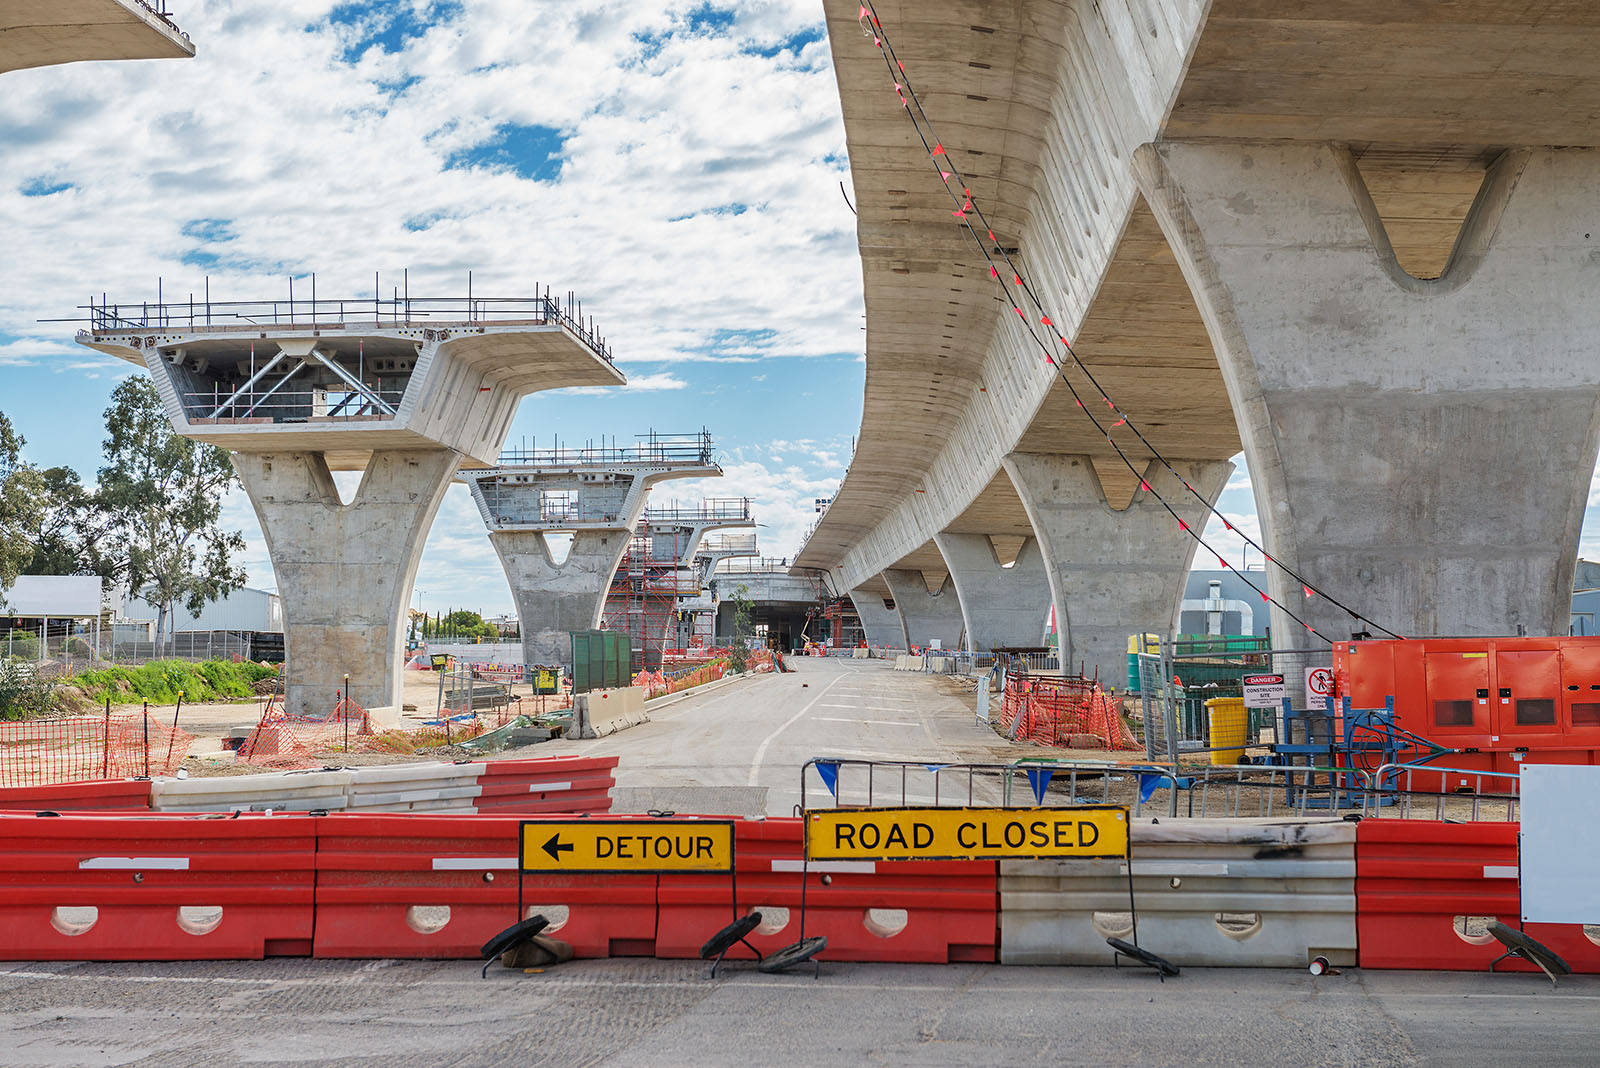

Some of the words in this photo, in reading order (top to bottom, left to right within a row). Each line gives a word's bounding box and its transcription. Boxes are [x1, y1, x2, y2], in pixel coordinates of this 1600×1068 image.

[596, 836, 714, 859] DETOUR
[836, 822, 935, 850] ROAD
[957, 820, 1100, 849] CLOSED
